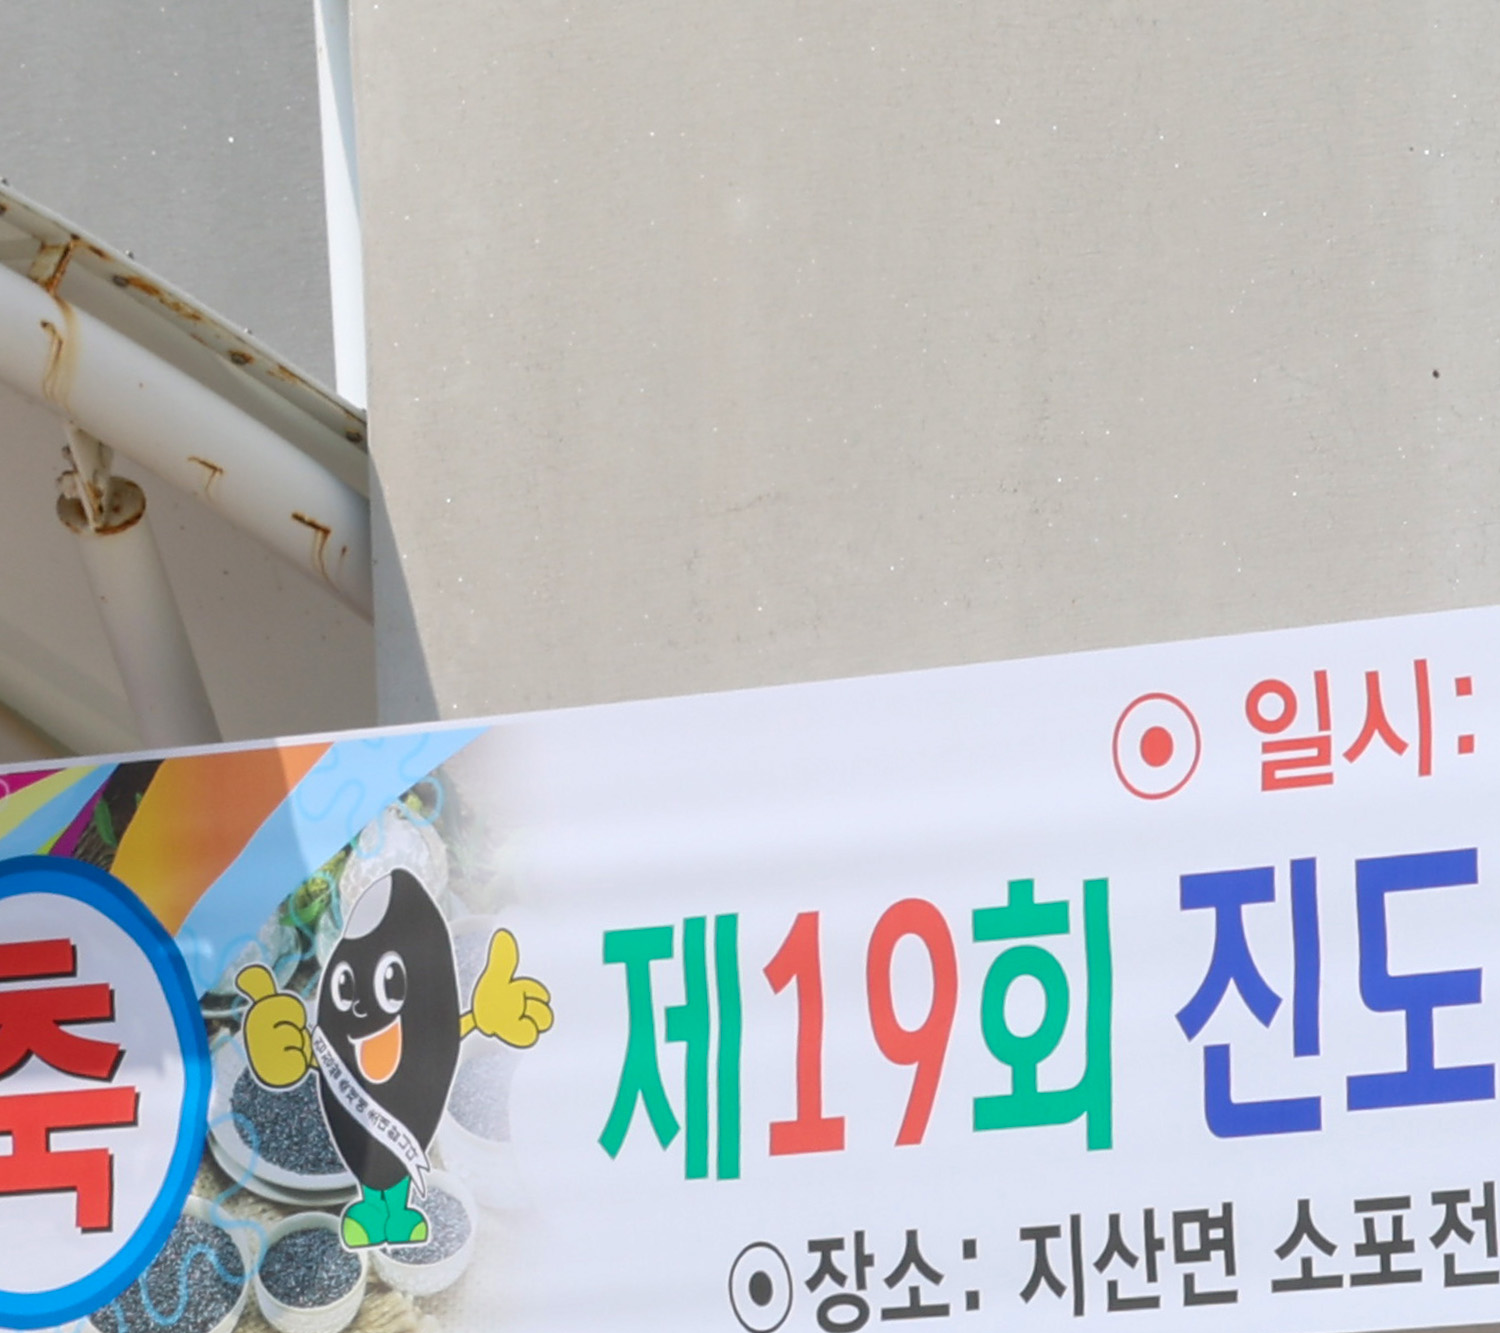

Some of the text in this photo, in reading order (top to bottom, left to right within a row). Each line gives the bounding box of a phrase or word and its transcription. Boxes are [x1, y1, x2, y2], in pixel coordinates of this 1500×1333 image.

[1246, 656, 1474, 791] 일시:
[598, 877, 1113, 1181] 제19회
[367, 1108, 419, 1162] 초대합니다
[805, 1230, 979, 1333] 장소:
[1020, 1202, 1238, 1316] 지산면
